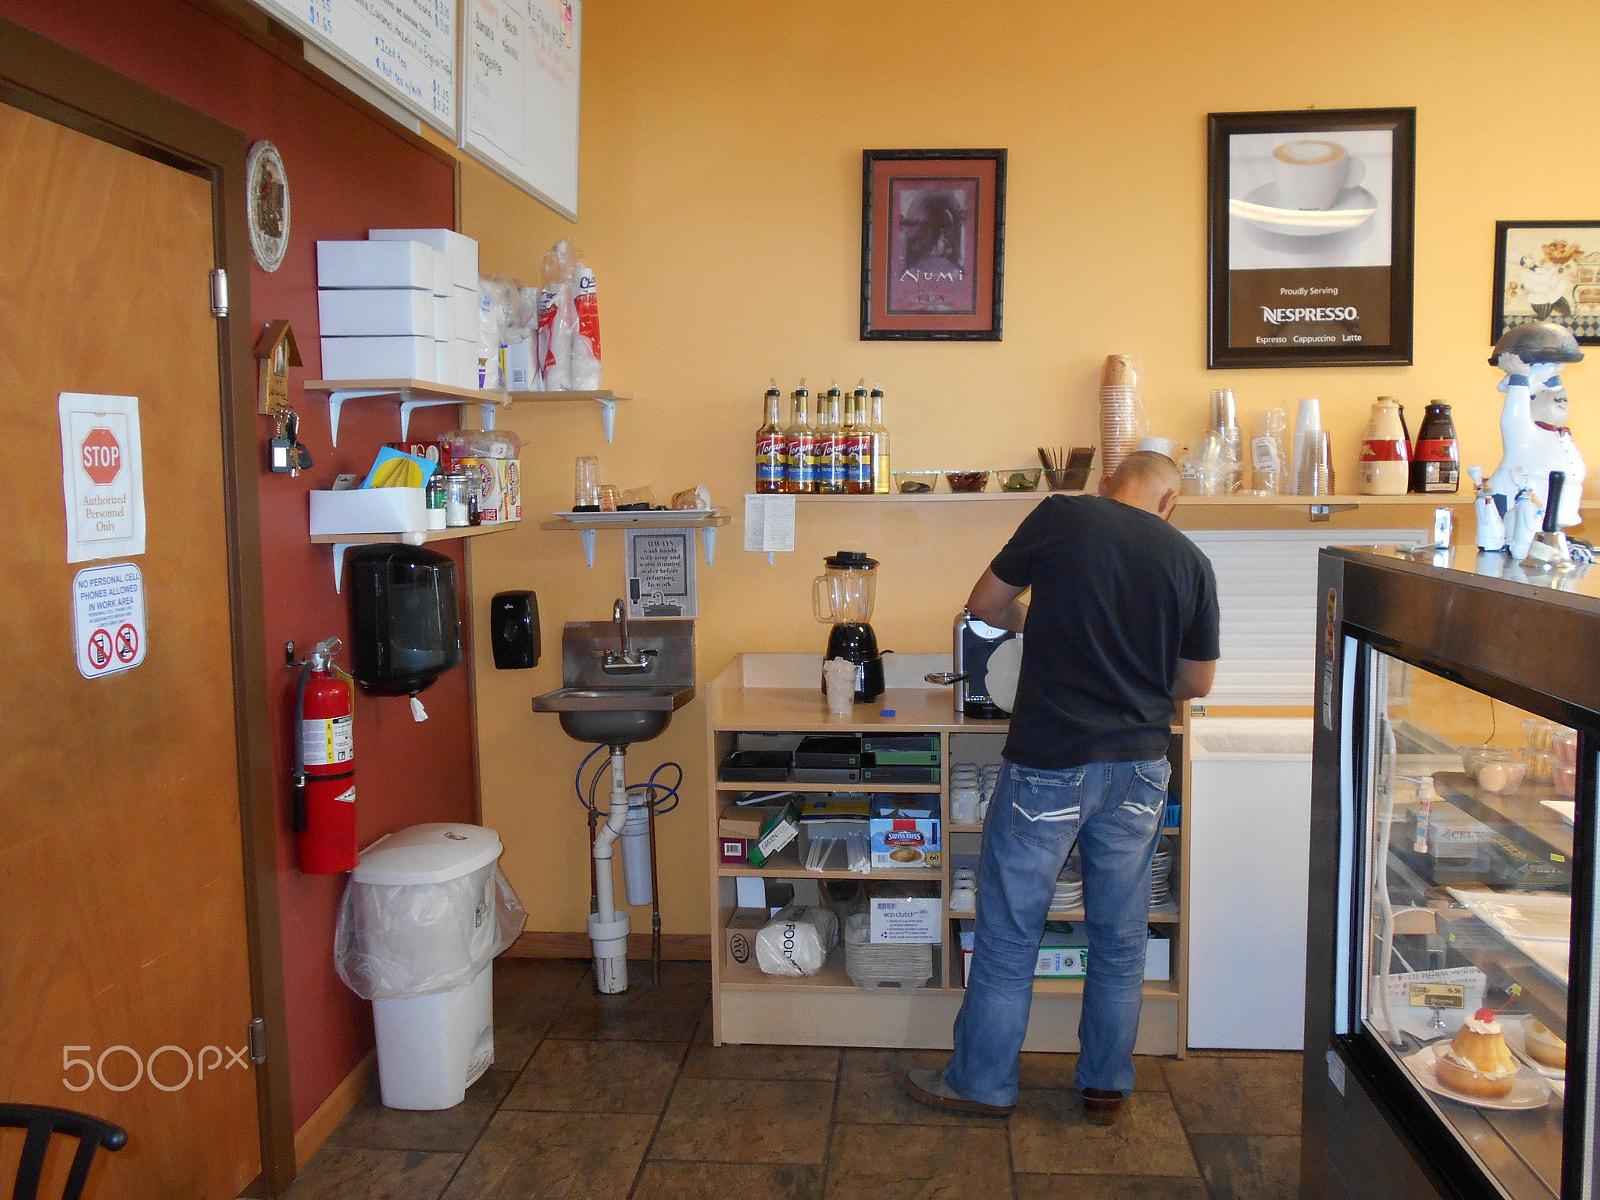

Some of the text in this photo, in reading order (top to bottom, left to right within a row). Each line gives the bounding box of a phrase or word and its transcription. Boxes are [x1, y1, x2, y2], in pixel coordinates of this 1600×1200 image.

[1280, 287, 1339, 296] Proudly Serving
[1260, 306, 1358, 325] NESPRESSO
[1256, 334, 1362, 345] Espresso Cappuccino Latte
[84, 446, 119, 467] STOP
[83, 494, 127, 506] Authorized
[86, 507, 124, 519] Personnel
[96, 521, 116, 532] Only
[78, 573, 139, 589] NO PERSONAL CELL
[80, 584, 138, 600] PHONES ALLOWED
[88, 597, 134, 611] IN WORK AREA
[762, 833, 779, 850] GREEN
[783, 924, 796, 959] FOOD
